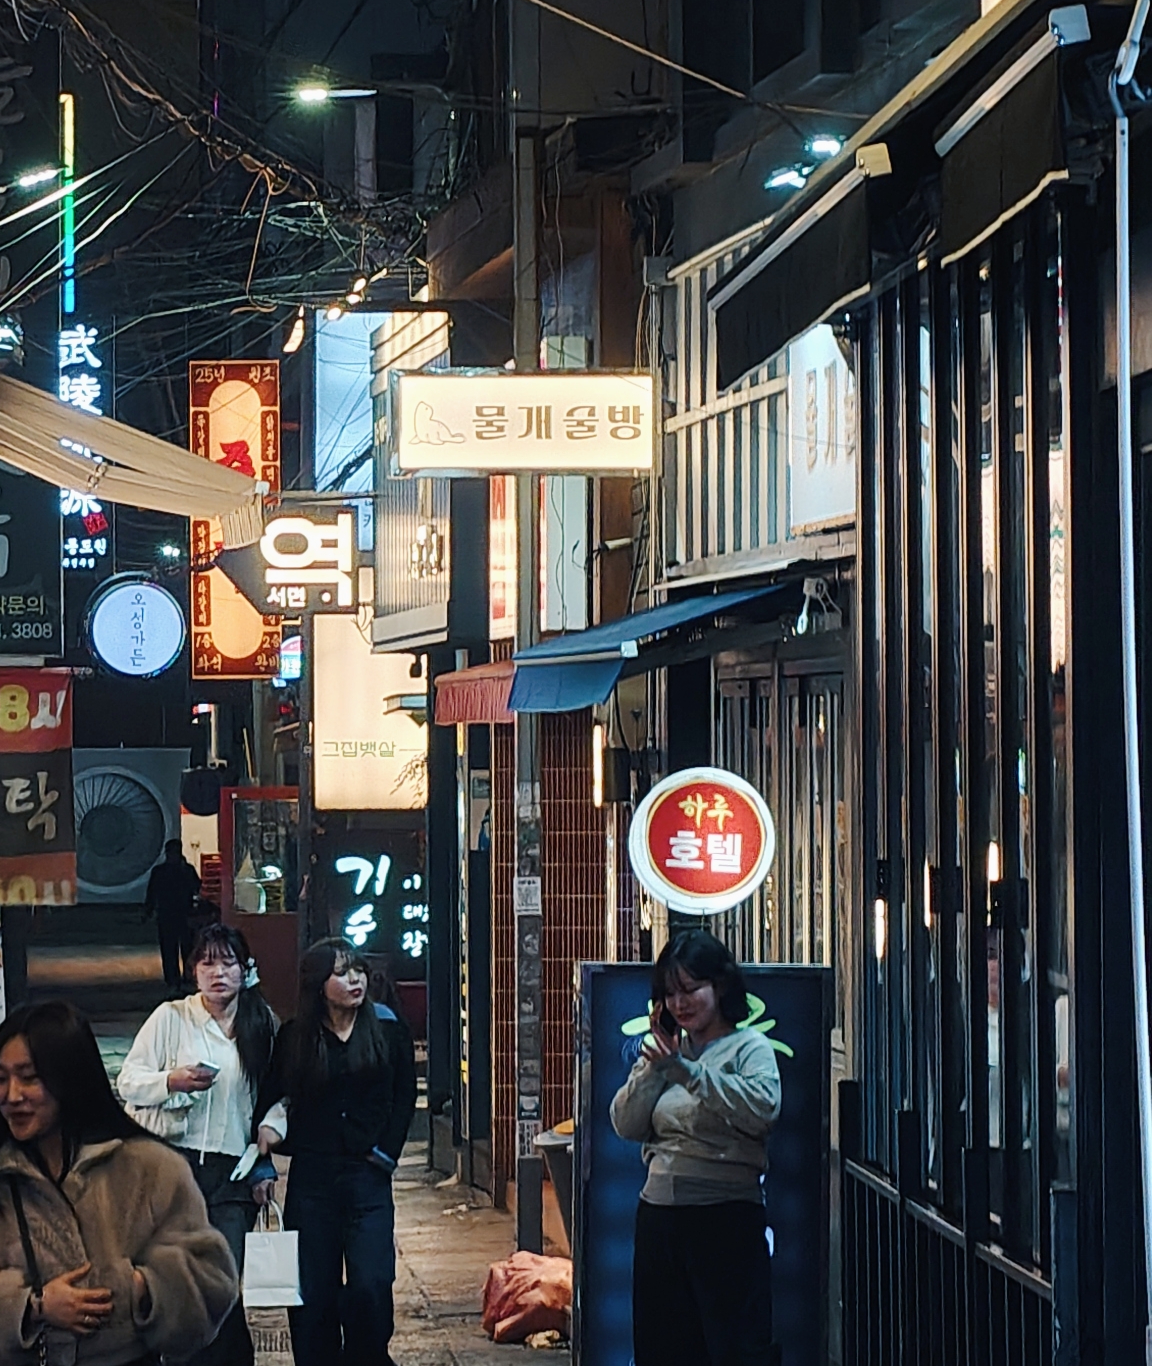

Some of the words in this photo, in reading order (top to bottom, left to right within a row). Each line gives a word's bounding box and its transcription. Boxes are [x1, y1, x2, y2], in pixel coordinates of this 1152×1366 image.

[471, 404, 645, 442] 물개술방
[260, 513, 352, 606] 역
[266, 586, 306, 608] 서면
[12, 622, 53, 639] 3808
[665, 830, 743, 874] 호텔
